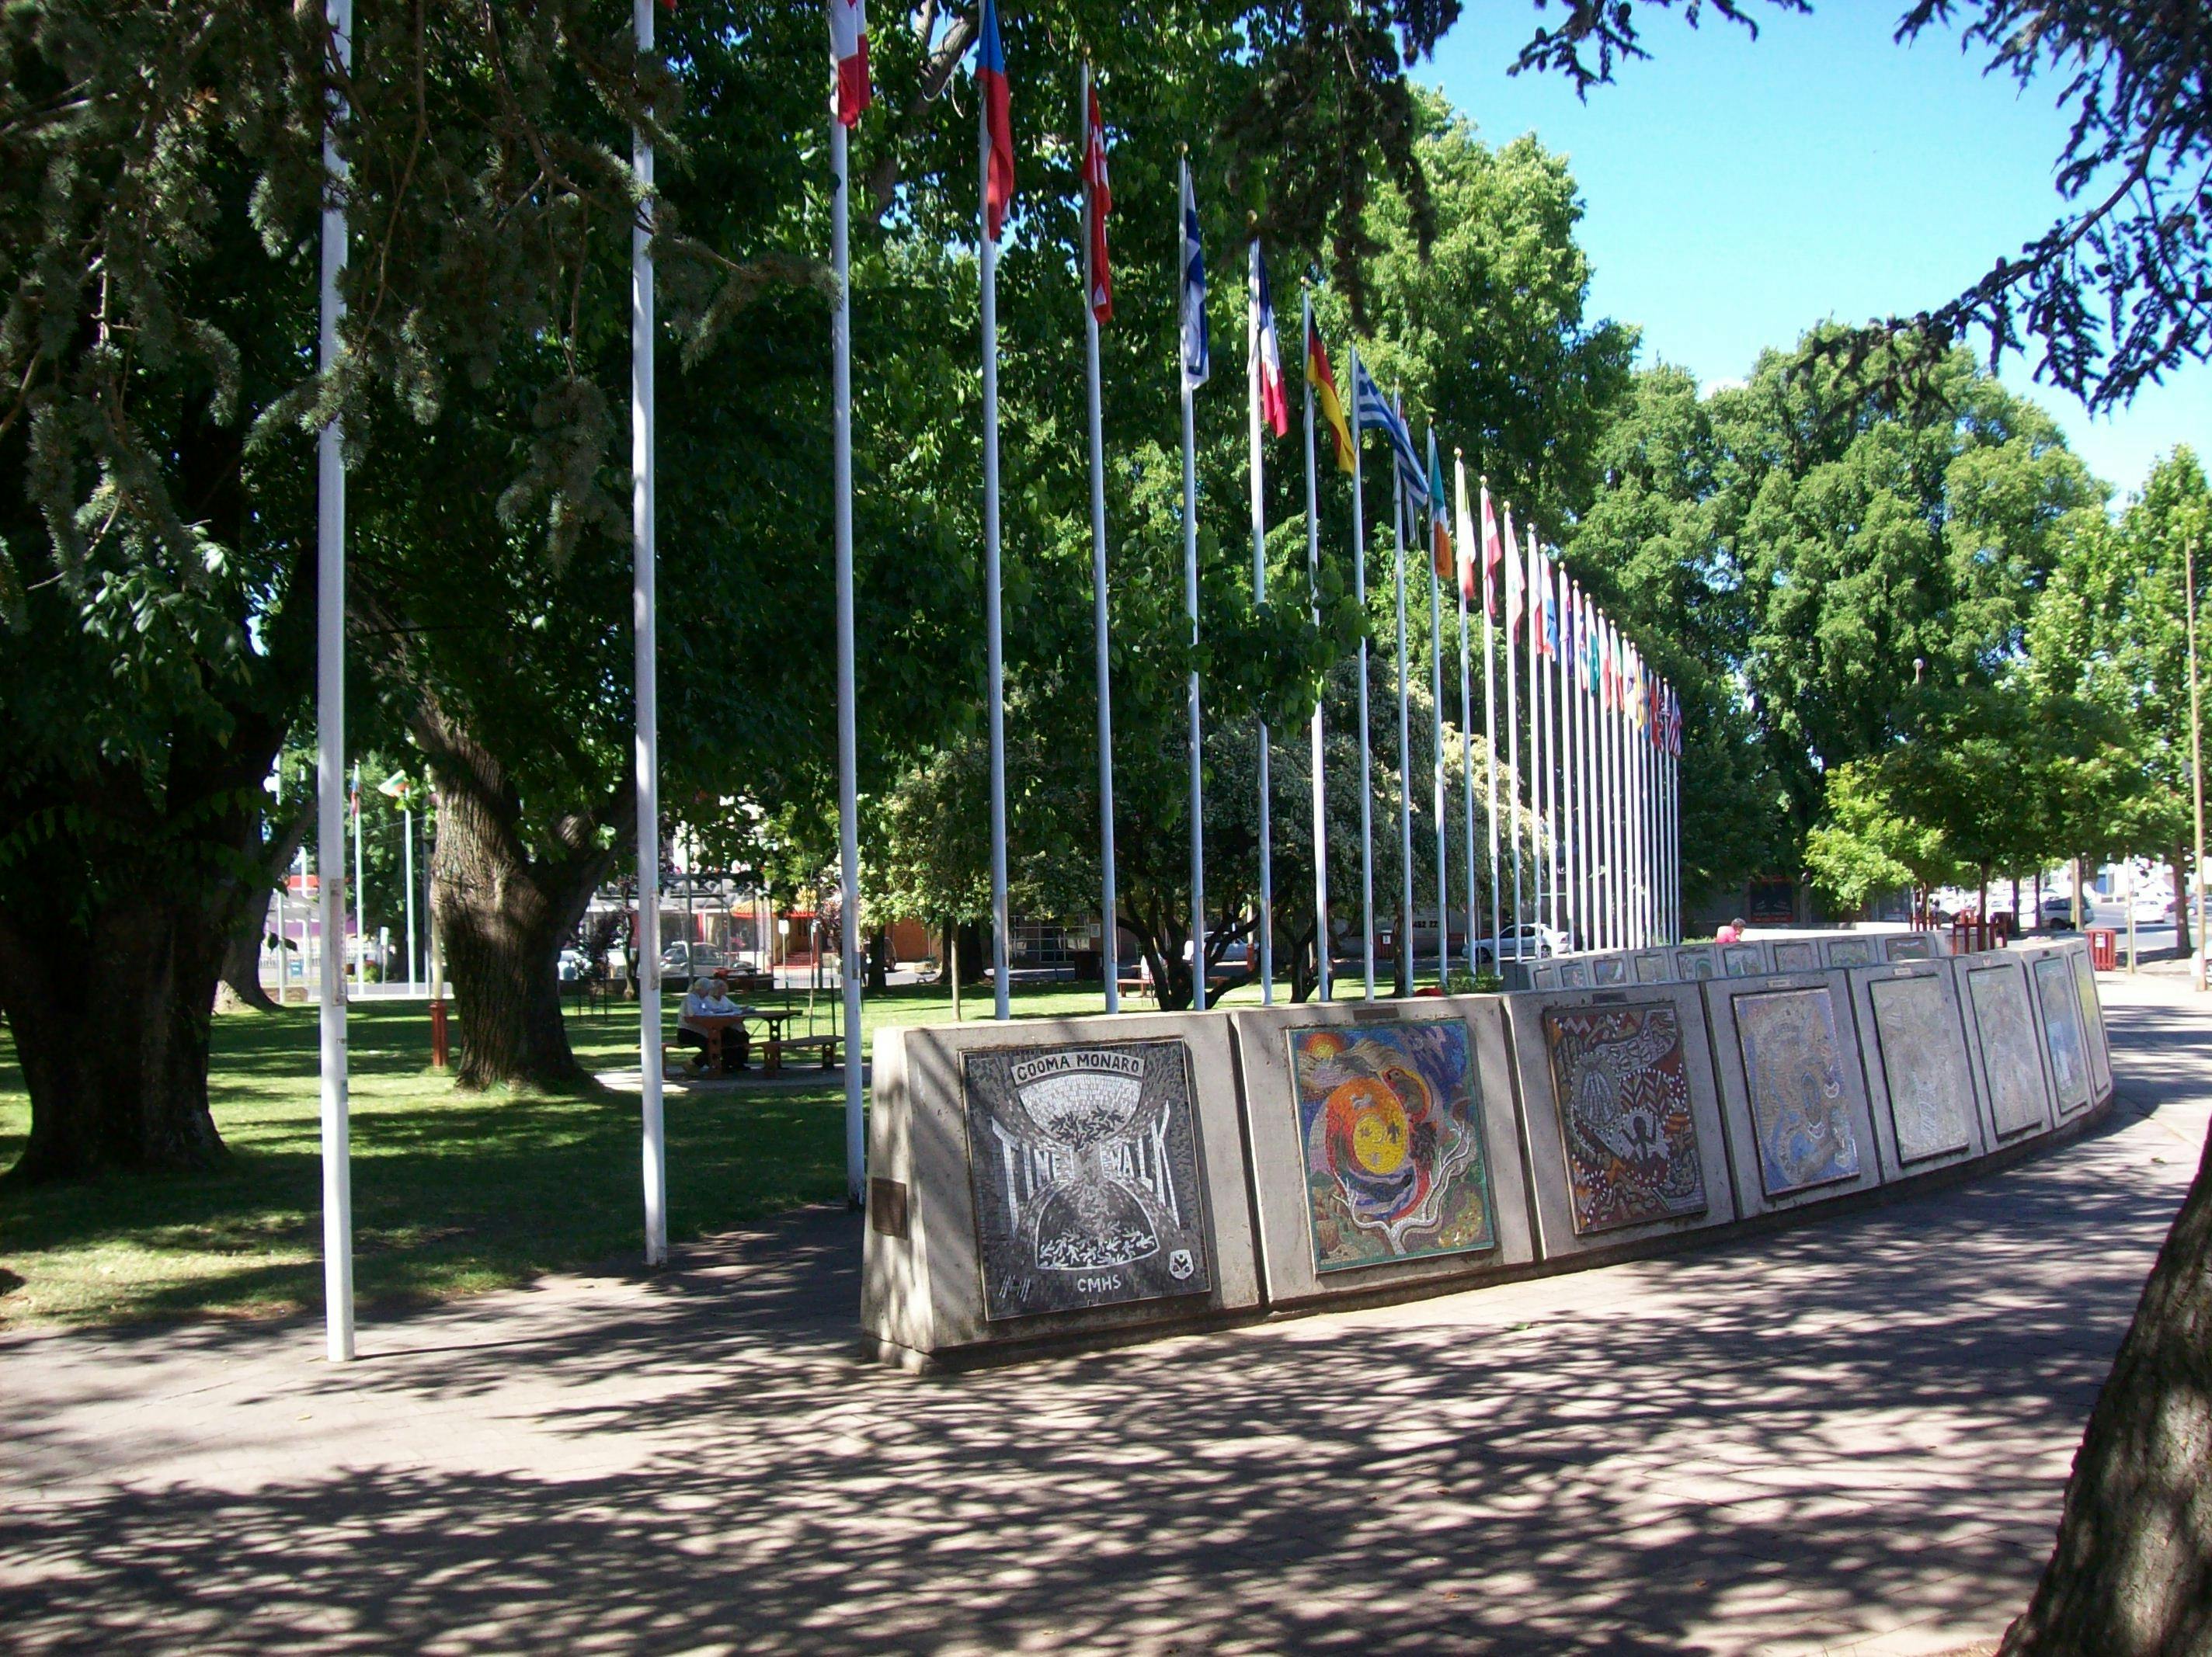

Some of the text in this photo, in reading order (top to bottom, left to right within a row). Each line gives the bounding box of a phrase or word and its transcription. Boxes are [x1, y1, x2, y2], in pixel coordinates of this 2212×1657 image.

[1017, 1054, 1139, 1081] COOMA MONARO
[1077, 1274, 1122, 1293] CMHS
